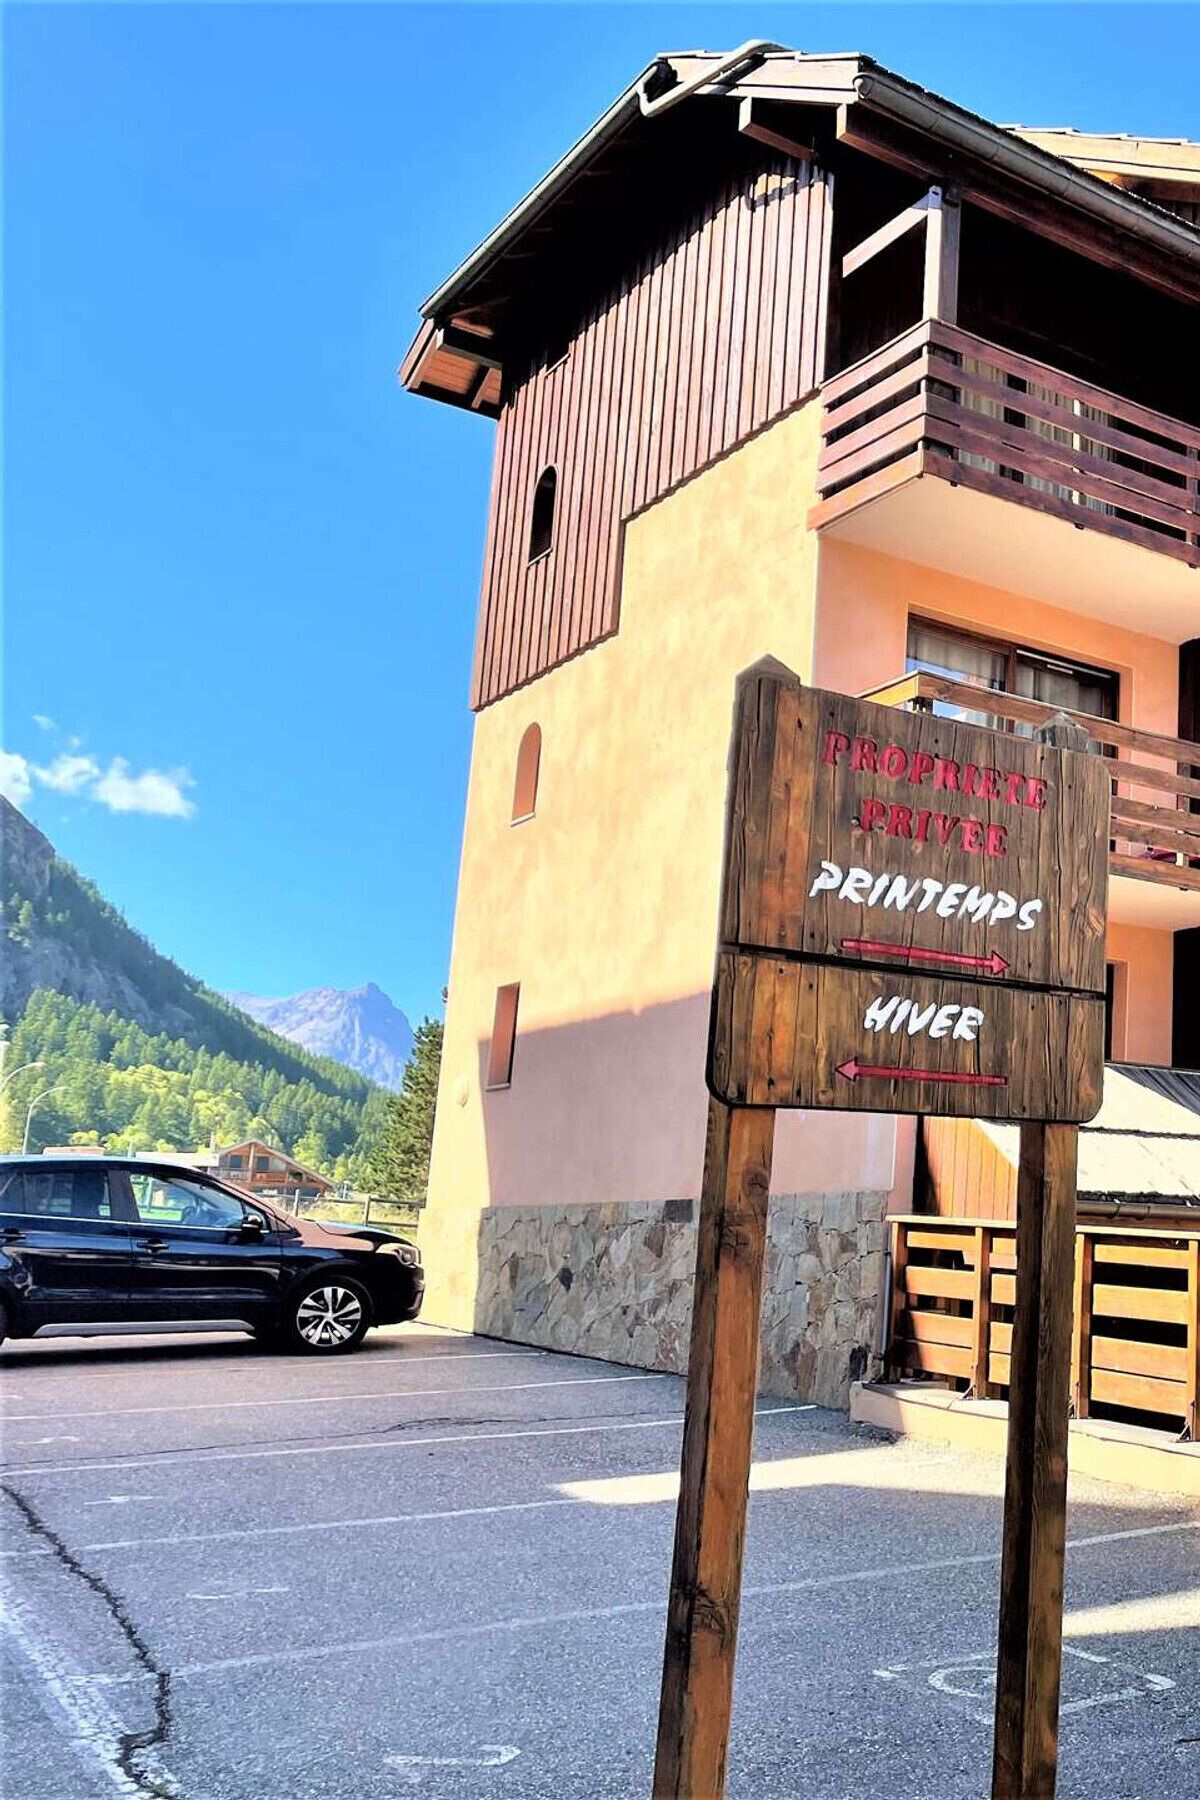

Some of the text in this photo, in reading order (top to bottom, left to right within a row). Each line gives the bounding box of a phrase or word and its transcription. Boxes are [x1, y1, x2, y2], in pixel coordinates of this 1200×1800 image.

[822, 731, 1048, 811] PROPRIETE
[859, 799, 1008, 857] PRIVEE
[808, 860, 1042, 929] PRINTEMPS
[863, 996, 984, 1041] HIVER
